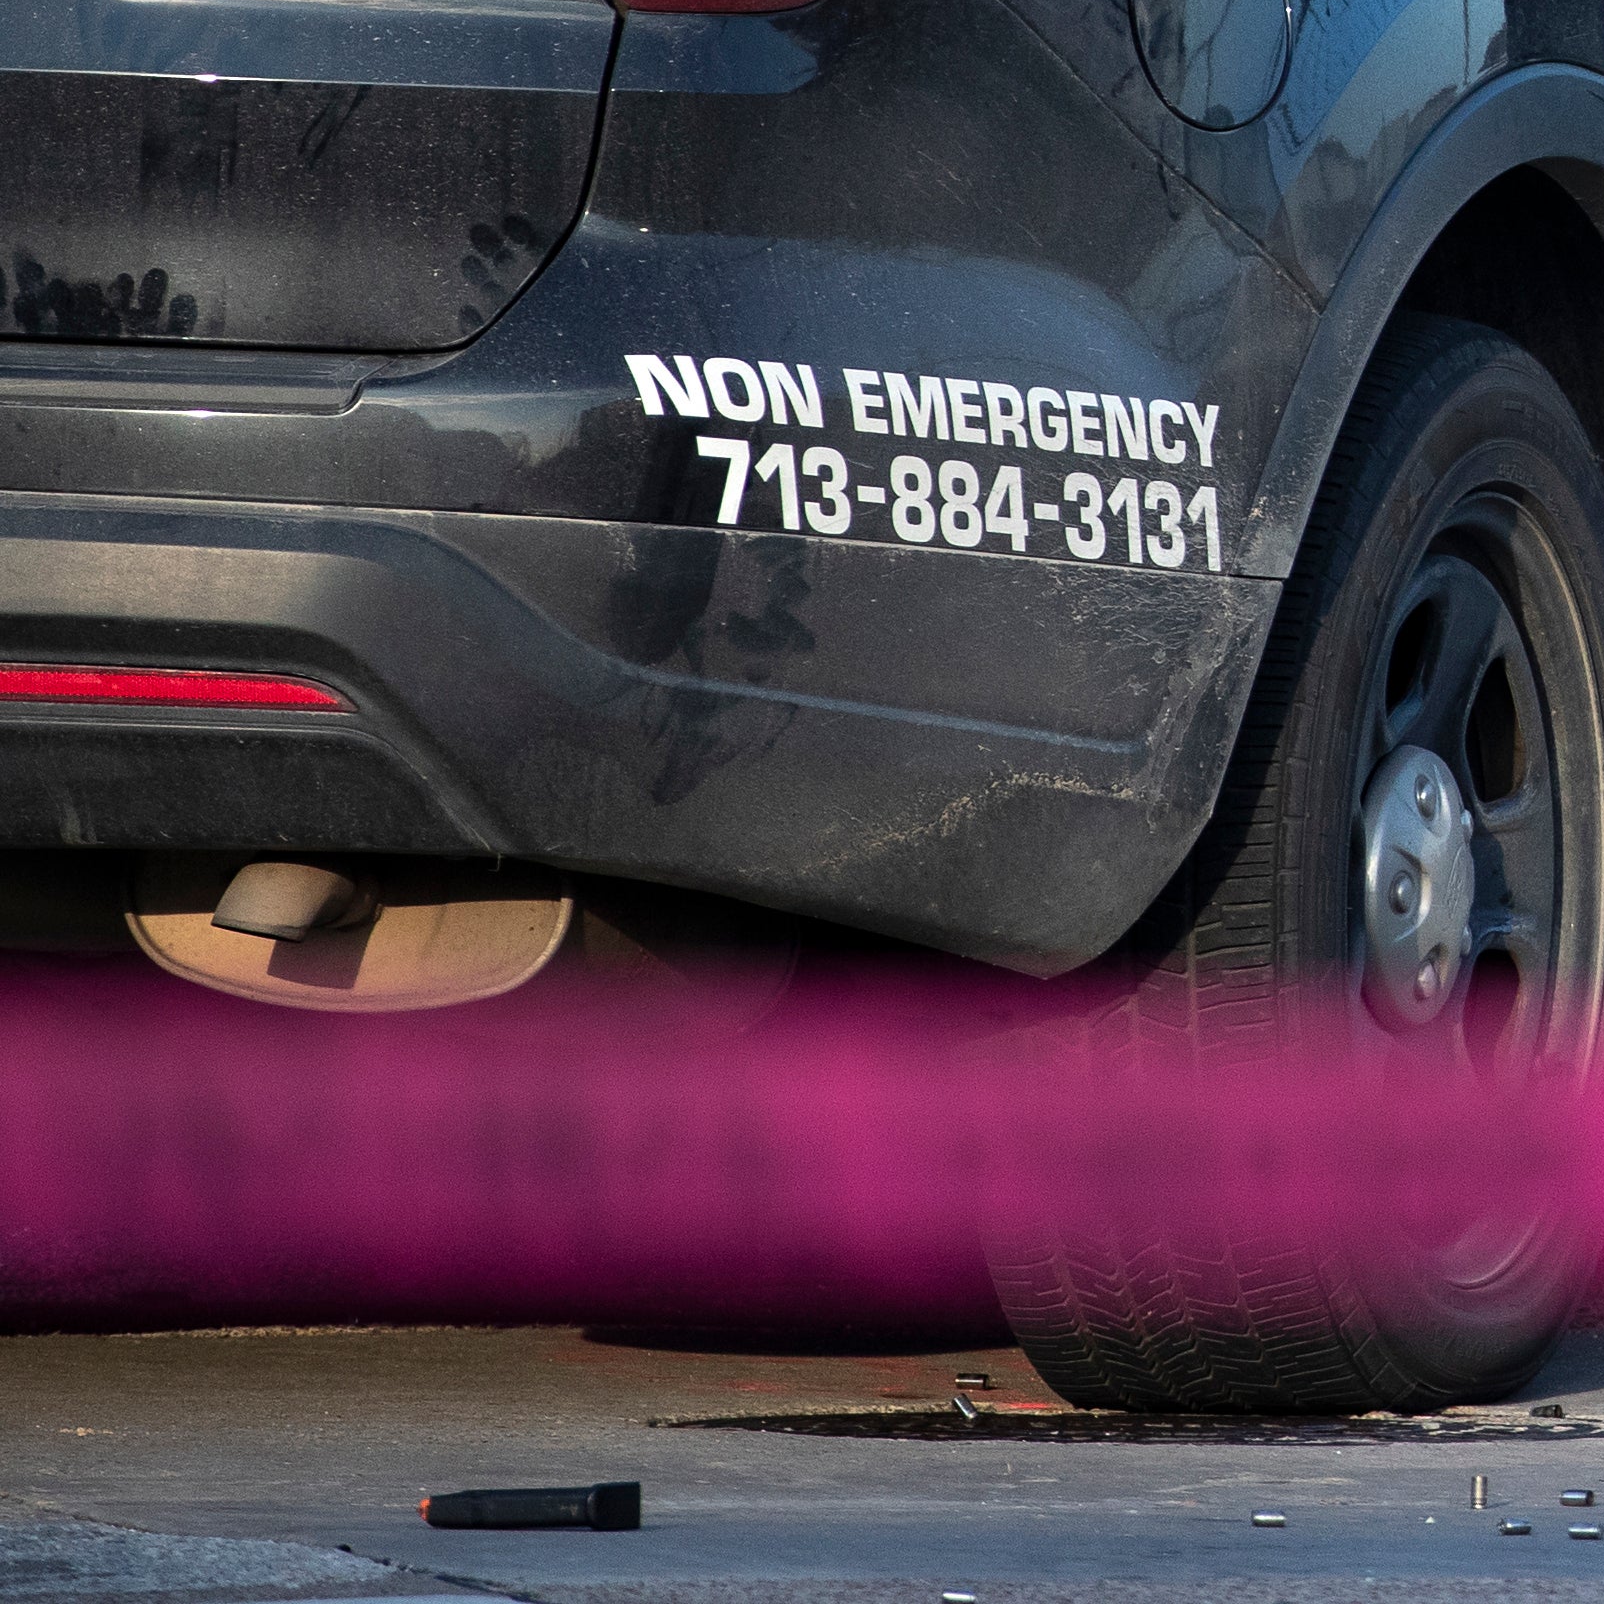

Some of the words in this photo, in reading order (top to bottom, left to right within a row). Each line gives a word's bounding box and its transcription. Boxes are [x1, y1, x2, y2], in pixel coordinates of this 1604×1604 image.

[623, 354, 823, 428] NON
[842, 367, 1220, 467] EMERGENCY
[695, 435, 1222, 572] 713-884-3131
